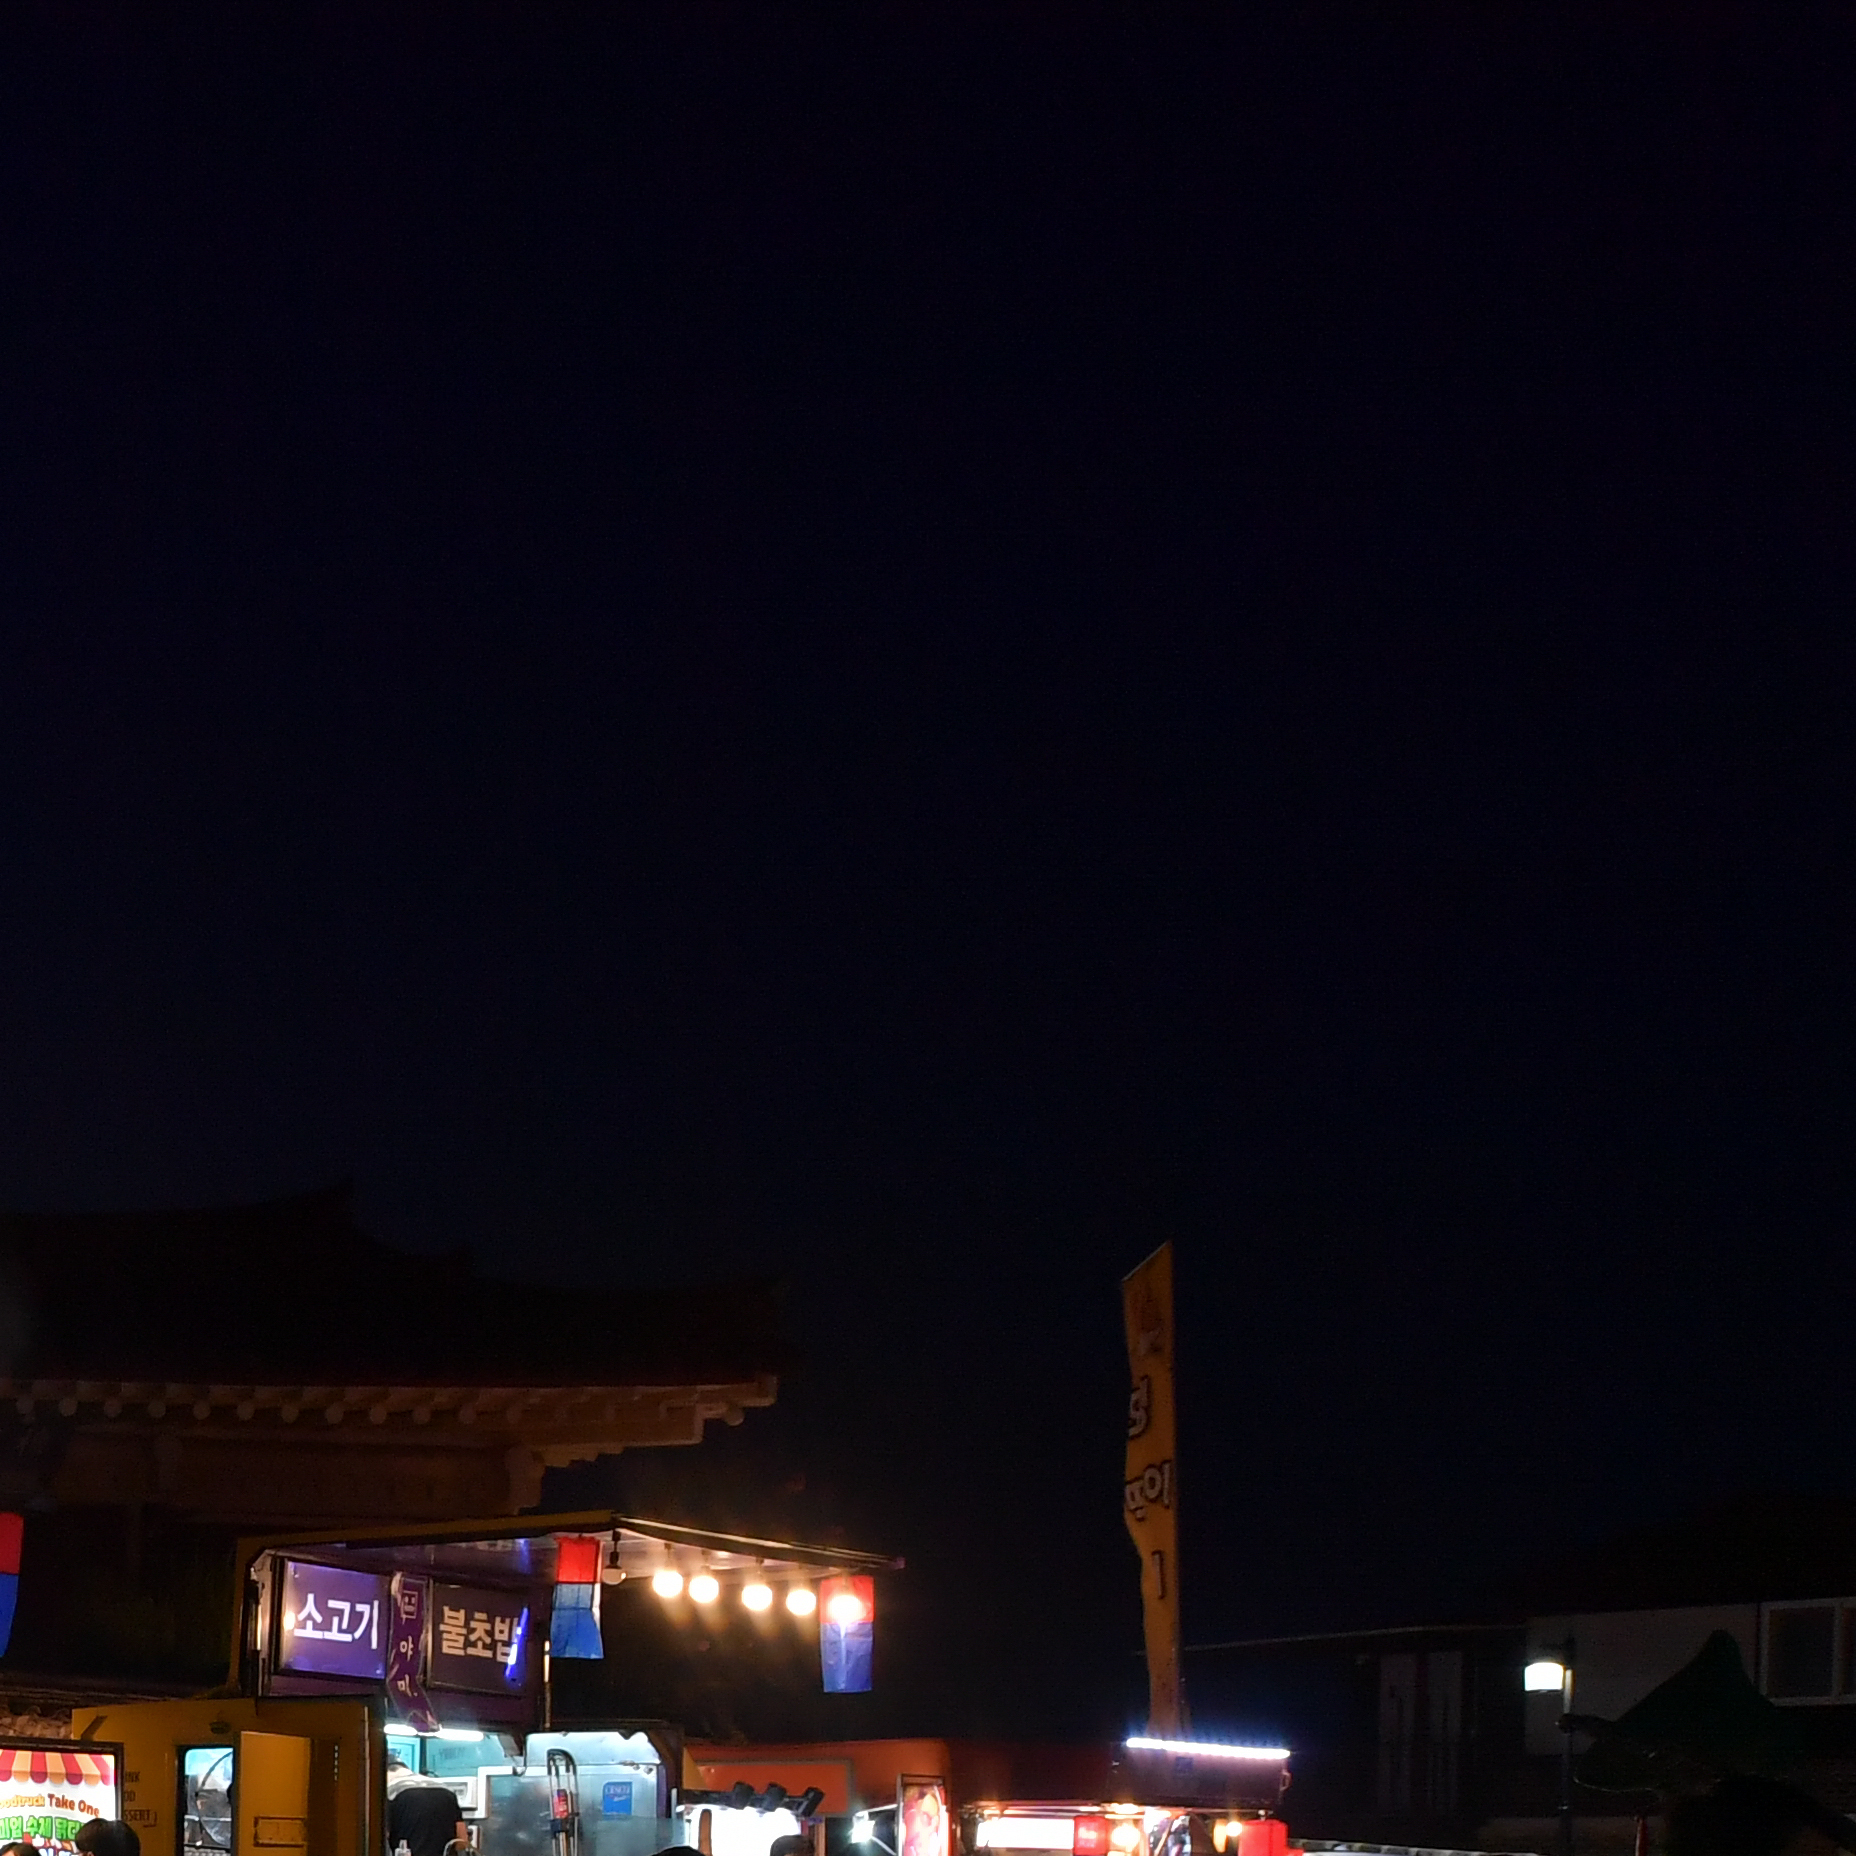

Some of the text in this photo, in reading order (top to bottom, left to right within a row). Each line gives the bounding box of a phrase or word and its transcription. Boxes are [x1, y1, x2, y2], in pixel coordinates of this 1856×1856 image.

[293, 1593, 379, 1650] 소고기
[439, 1605, 520, 1663] 불초밥
[125, 1771, 141, 1783] INK
[47, 1793, 76, 1812] Take
[77, 1799, 100, 1817] One
[124, 1809, 151, 1822] SSERT
[25, 1815, 53, 1840] 수제
